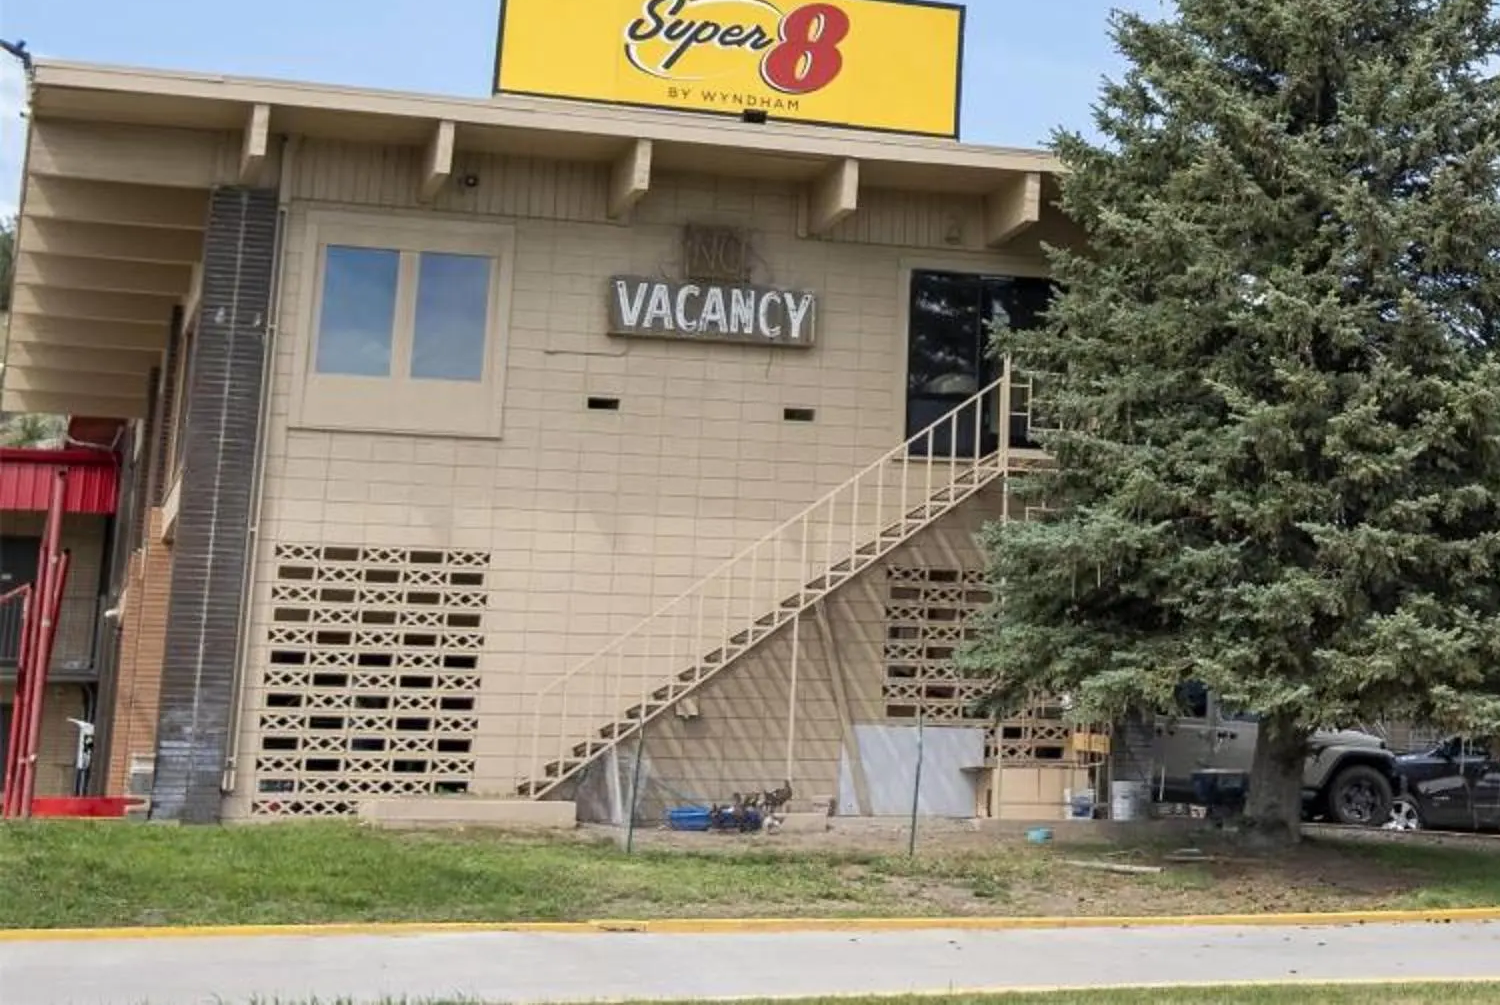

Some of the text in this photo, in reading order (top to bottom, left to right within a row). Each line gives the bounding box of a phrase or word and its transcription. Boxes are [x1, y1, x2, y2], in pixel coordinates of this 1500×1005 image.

[761, 3, 850, 94] 8
[668, 86, 800, 112] BY WYNDHAM
[615, 280, 814, 339] VACANCY
